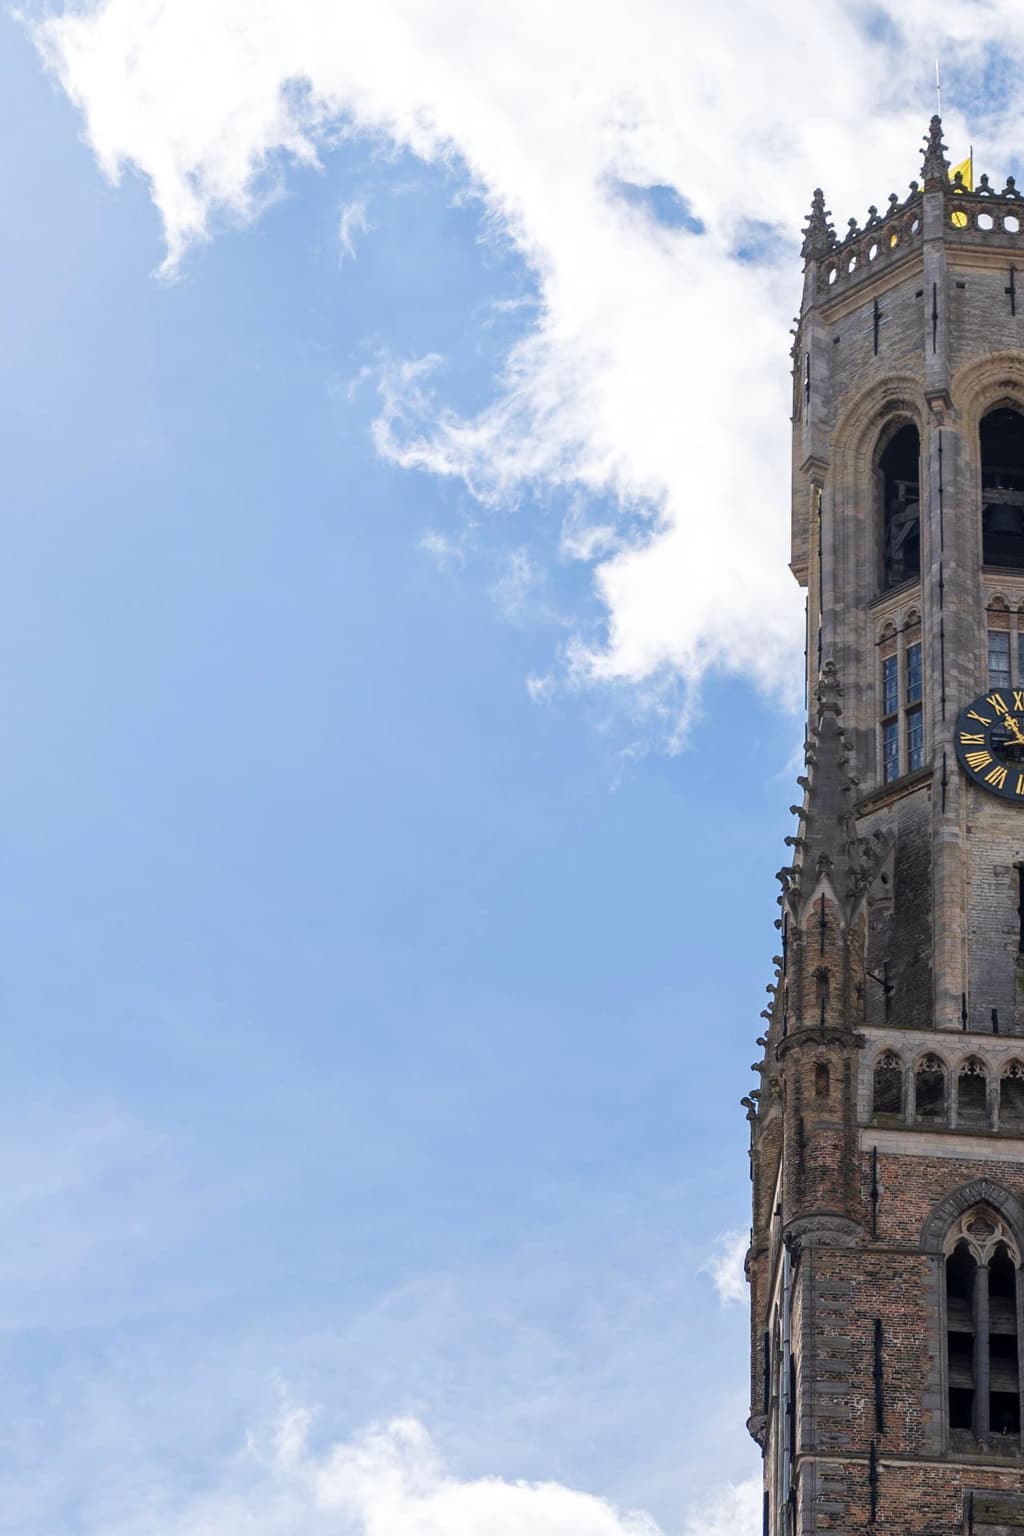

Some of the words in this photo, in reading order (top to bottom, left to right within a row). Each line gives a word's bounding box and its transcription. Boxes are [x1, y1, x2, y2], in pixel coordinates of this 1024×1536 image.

[986, 693, 1008, 716] XI
[967, 710, 992, 727] X
[960, 731, 985, 745] IX
[965, 750, 993, 773] VIII
[984, 766, 1008, 790] VII
